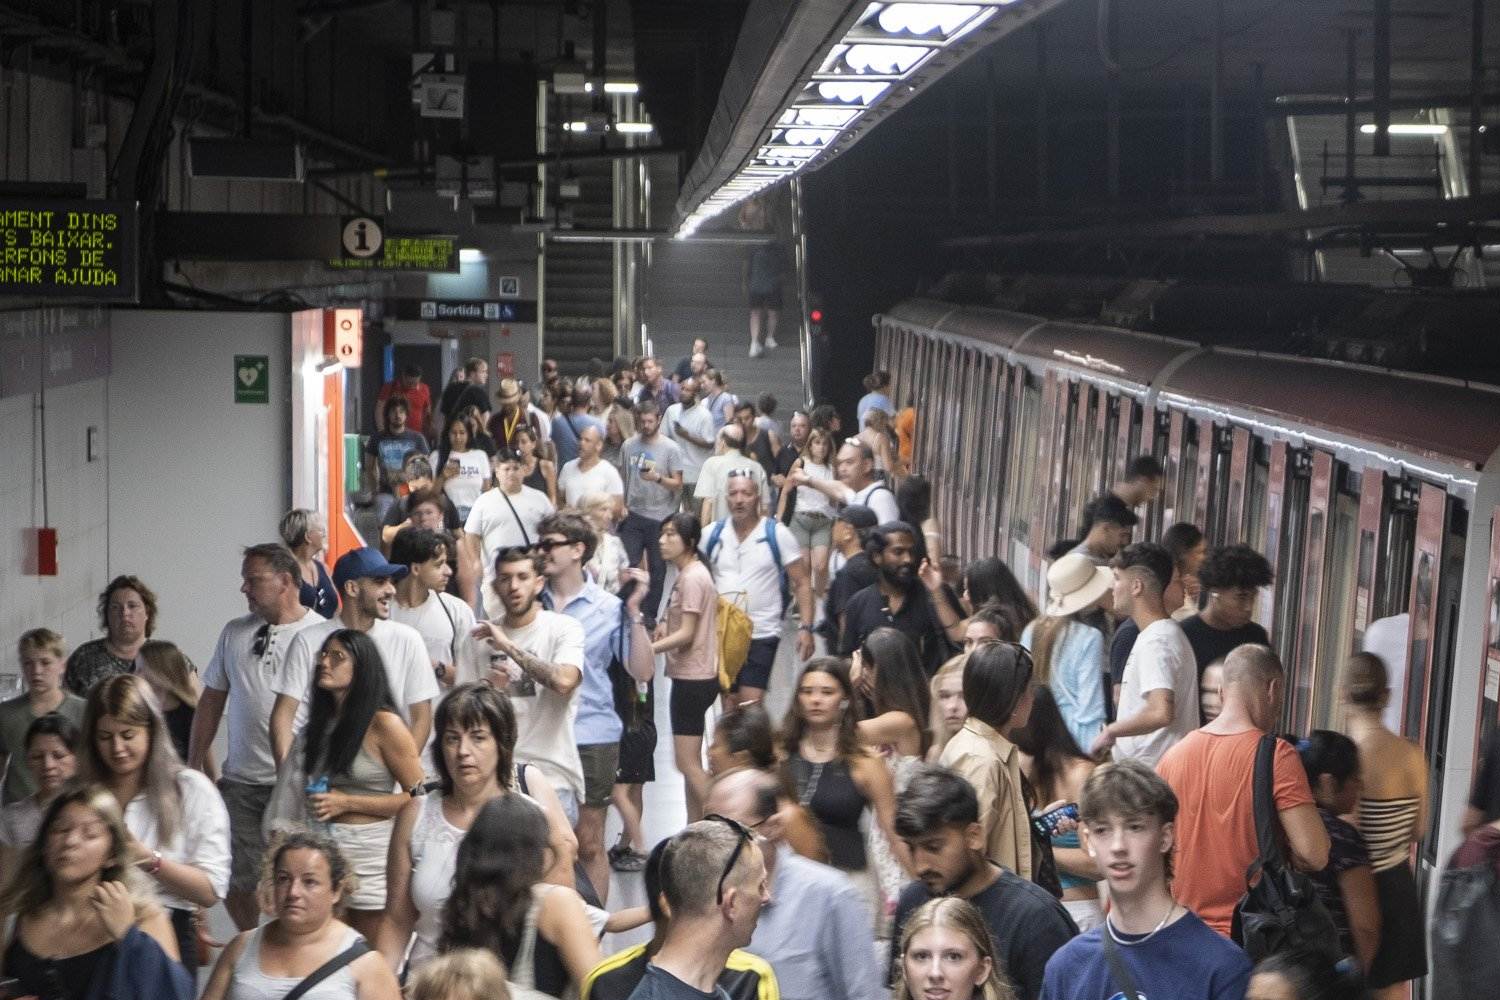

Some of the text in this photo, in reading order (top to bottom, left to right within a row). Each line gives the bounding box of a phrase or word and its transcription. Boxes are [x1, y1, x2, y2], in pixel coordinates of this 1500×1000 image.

[68, 211, 117, 231] DINS
[31, 229, 113, 249] BAIXAR.
[80, 249, 105, 267] DE
[55, 267, 117, 286] AJUDA
[438, 303, 481, 317] Sortida
